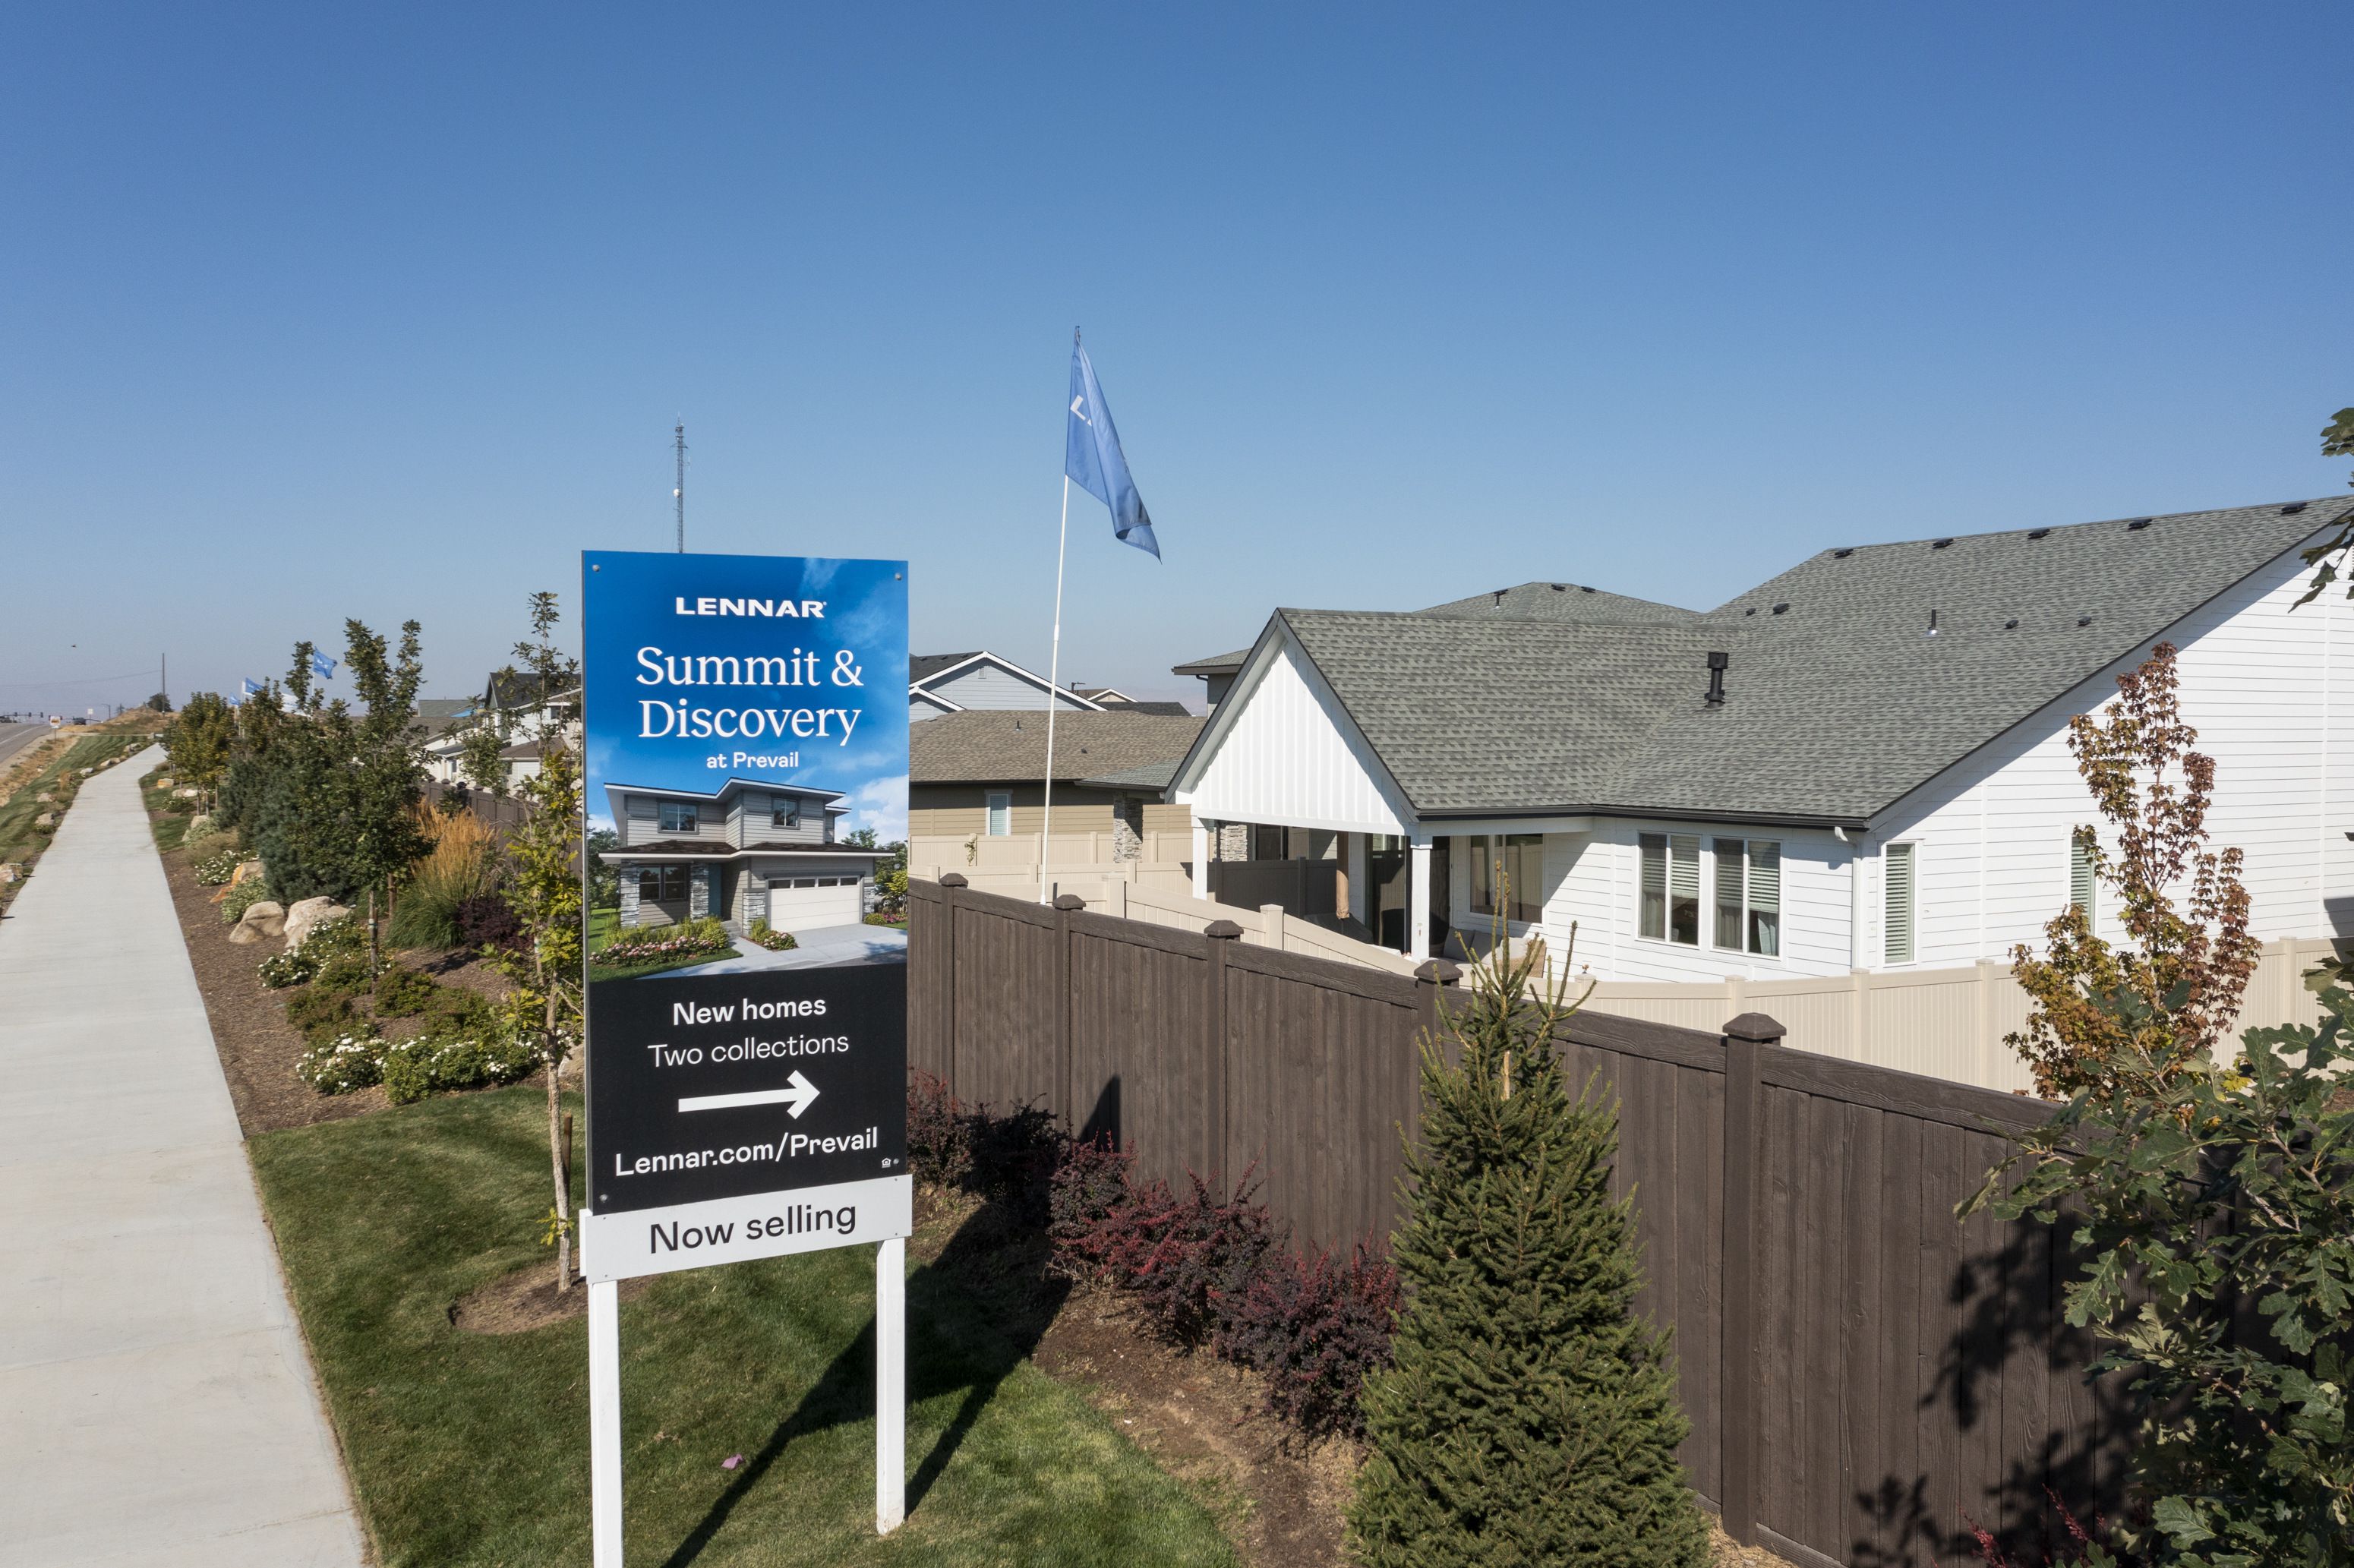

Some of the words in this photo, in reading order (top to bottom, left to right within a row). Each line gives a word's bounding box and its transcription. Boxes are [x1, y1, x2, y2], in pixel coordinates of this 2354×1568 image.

[676, 597, 825, 618] LENNAR
[636, 646, 821, 686] Summit
[831, 649, 864, 686] &
[639, 698, 862, 746] Discovery
[706, 753, 727, 768] at
[733, 751, 799, 768] Prevail
[673, 1002, 735, 1026] New
[742, 998, 827, 1021] homes
[647, 1043, 703, 1068] Two
[711, 1034, 849, 1062] collections
[615, 1126, 879, 1177] Lennar.com/Prevail
[650, 1221, 735, 1254] Now
[746, 1204, 856, 1240] selling
